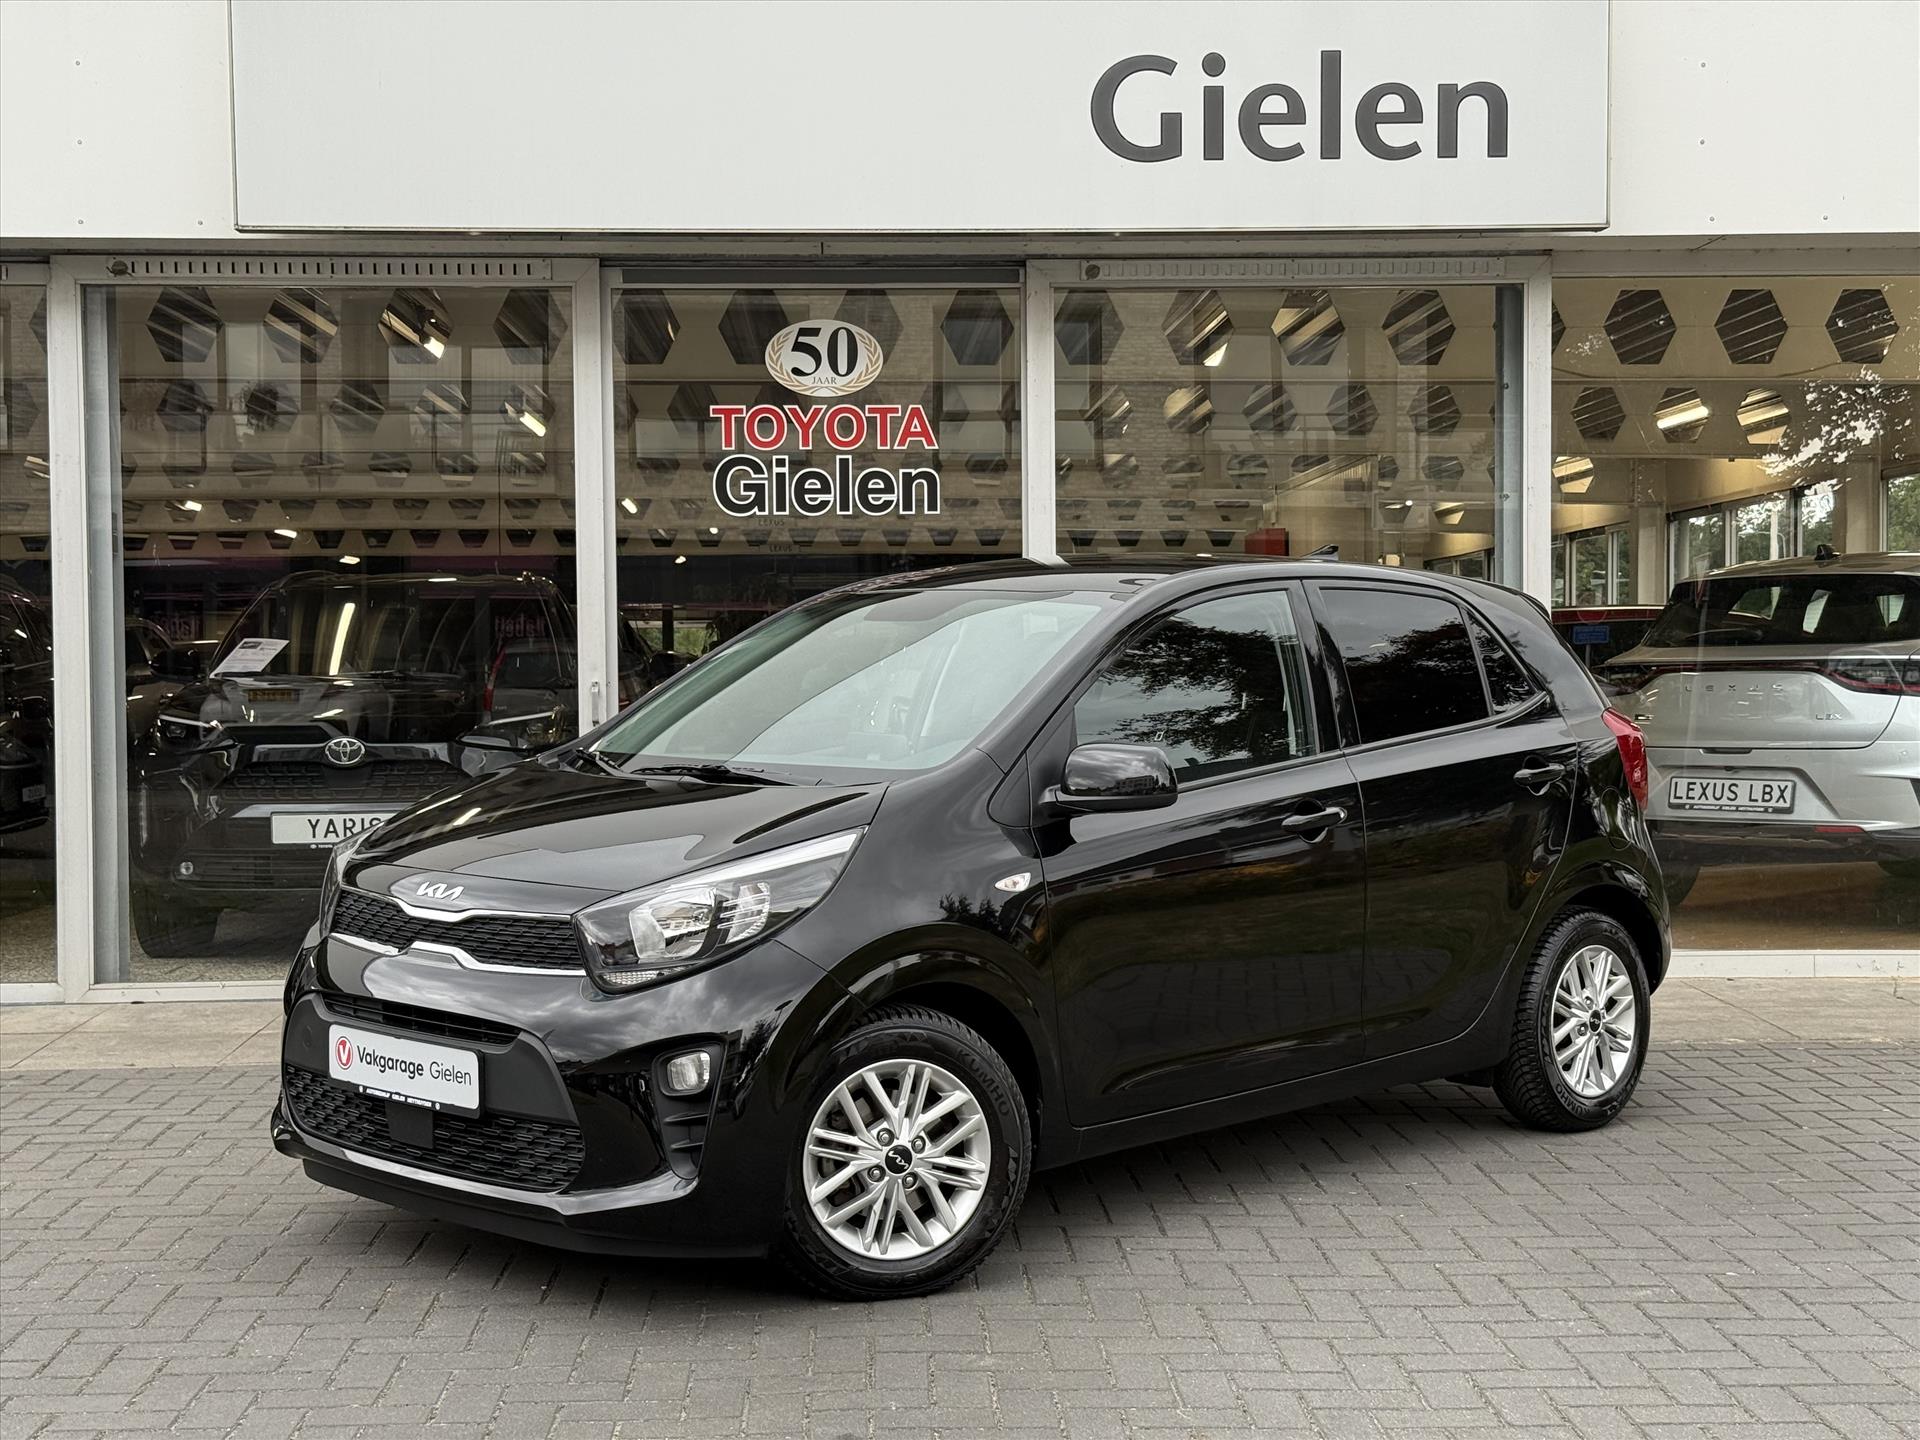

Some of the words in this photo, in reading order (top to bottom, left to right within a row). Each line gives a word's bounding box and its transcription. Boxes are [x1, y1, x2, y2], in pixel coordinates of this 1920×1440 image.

[1090, 50, 1509, 163] Gielen
[790, 326, 859, 378] 50
[811, 376, 838, 385] JAAR
[709, 404, 939, 451] TOYOTA
[712, 453, 941, 517] Gielen
[1673, 781, 1739, 802] LEXUS
[1748, 783, 1788, 804] LBX
[357, 1045, 424, 1080] Vakgarage
[429, 1061, 472, 1086] Gielen
[956, 1048, 1009, 1116] KUMHO
